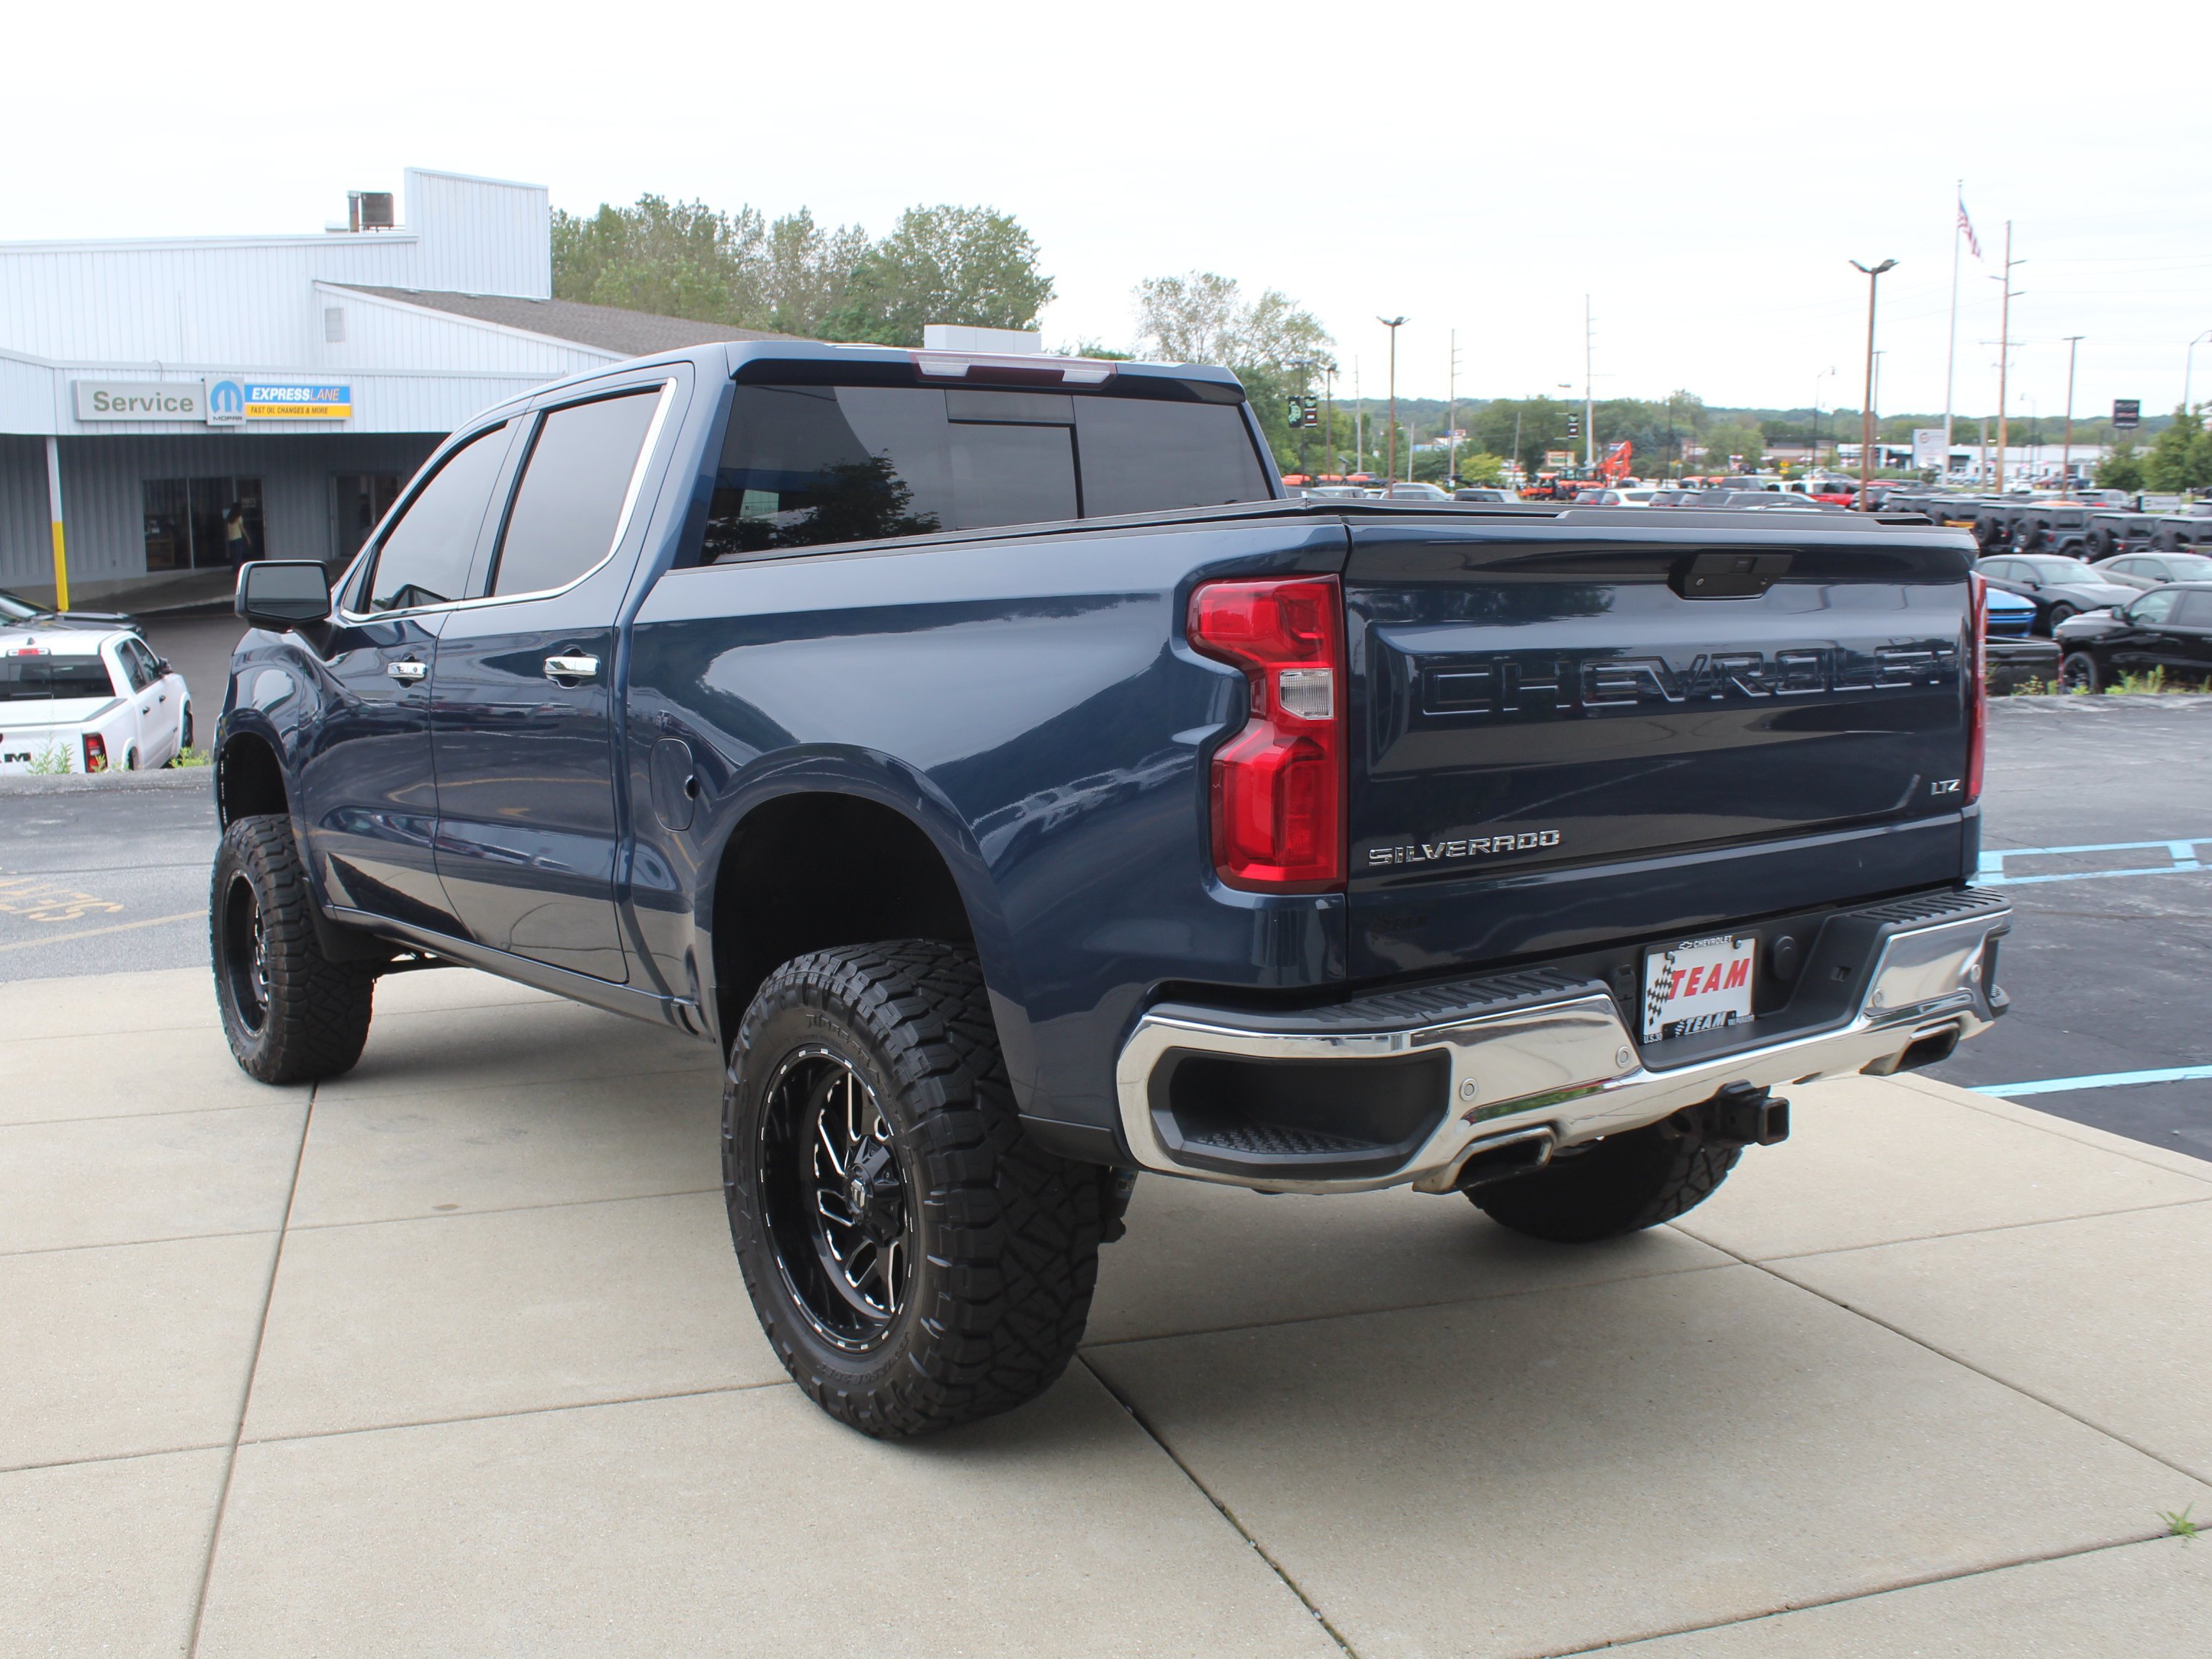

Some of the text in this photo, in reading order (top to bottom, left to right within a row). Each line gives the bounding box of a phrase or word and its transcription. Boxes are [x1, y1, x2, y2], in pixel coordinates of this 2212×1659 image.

[93, 390, 194, 412] Service
[1423, 643, 1954, 714] CHEVROLET
[1930, 778, 1961, 795] LTZ
[1369, 830, 1560, 866] SILVERADO
[1694, 935, 1732, 948] CHEVROLET
[1667, 958, 1750, 1000] TEAM
[1684, 1011, 1727, 1033] TEAM
